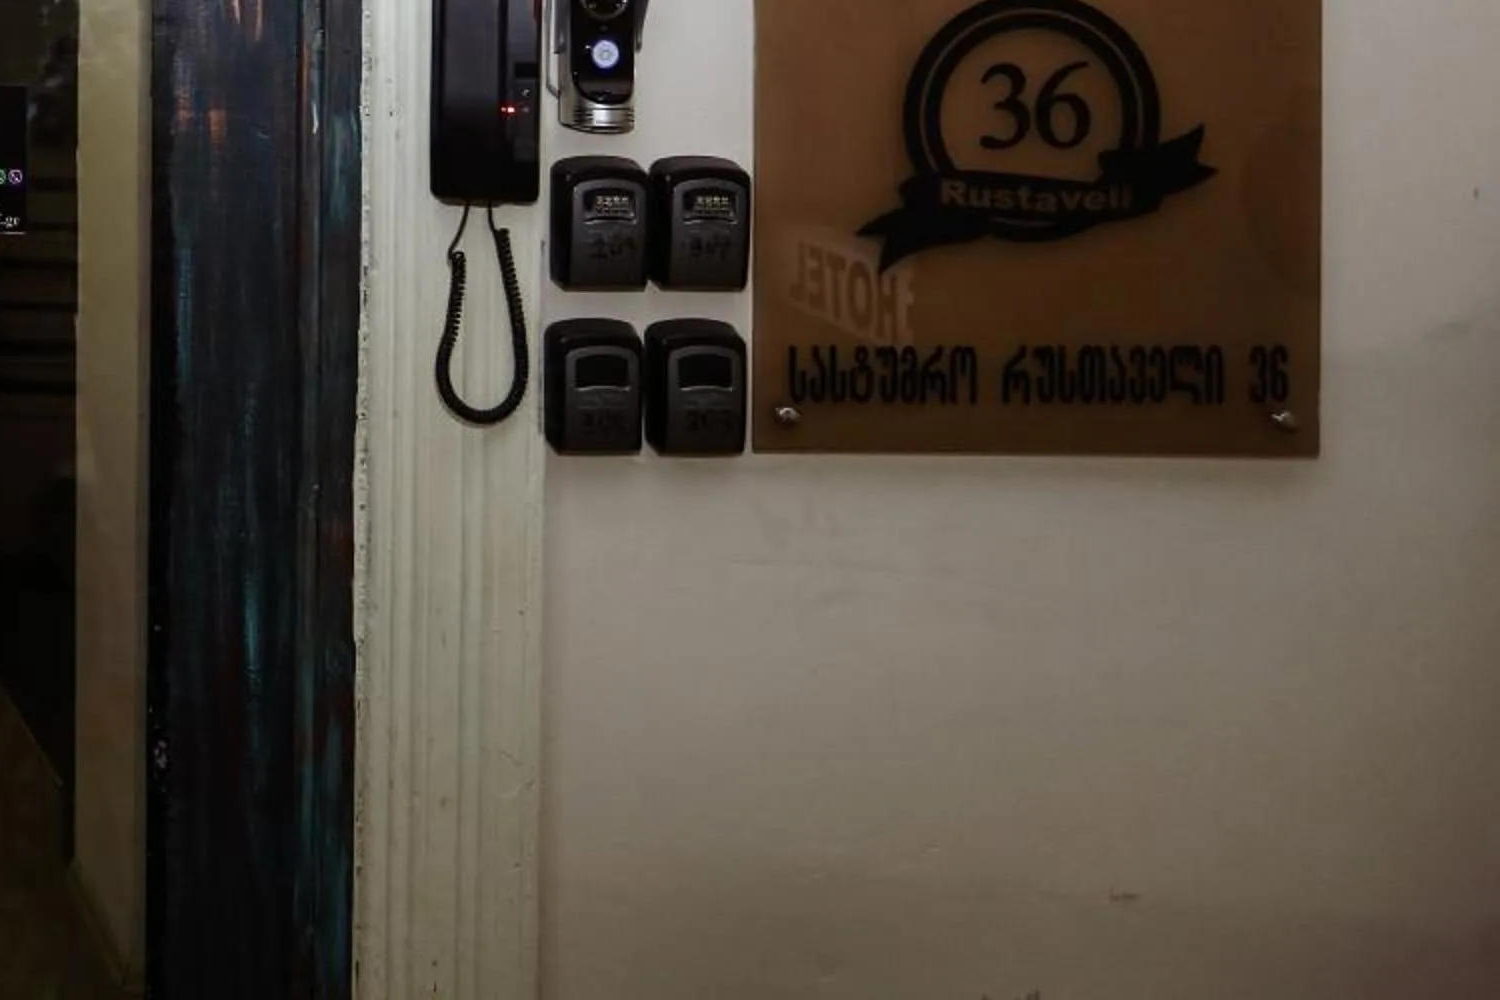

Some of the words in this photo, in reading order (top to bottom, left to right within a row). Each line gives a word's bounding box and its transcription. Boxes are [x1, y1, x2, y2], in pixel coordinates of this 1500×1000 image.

[979, 60, 1092, 151] 36
[939, 177, 1134, 214] Rustaveli
[786, 344, 977, 406] სასტუმრო
[1001, 344, 1225, 406] რუსთაველი
[1249, 344, 1290, 404] 36
